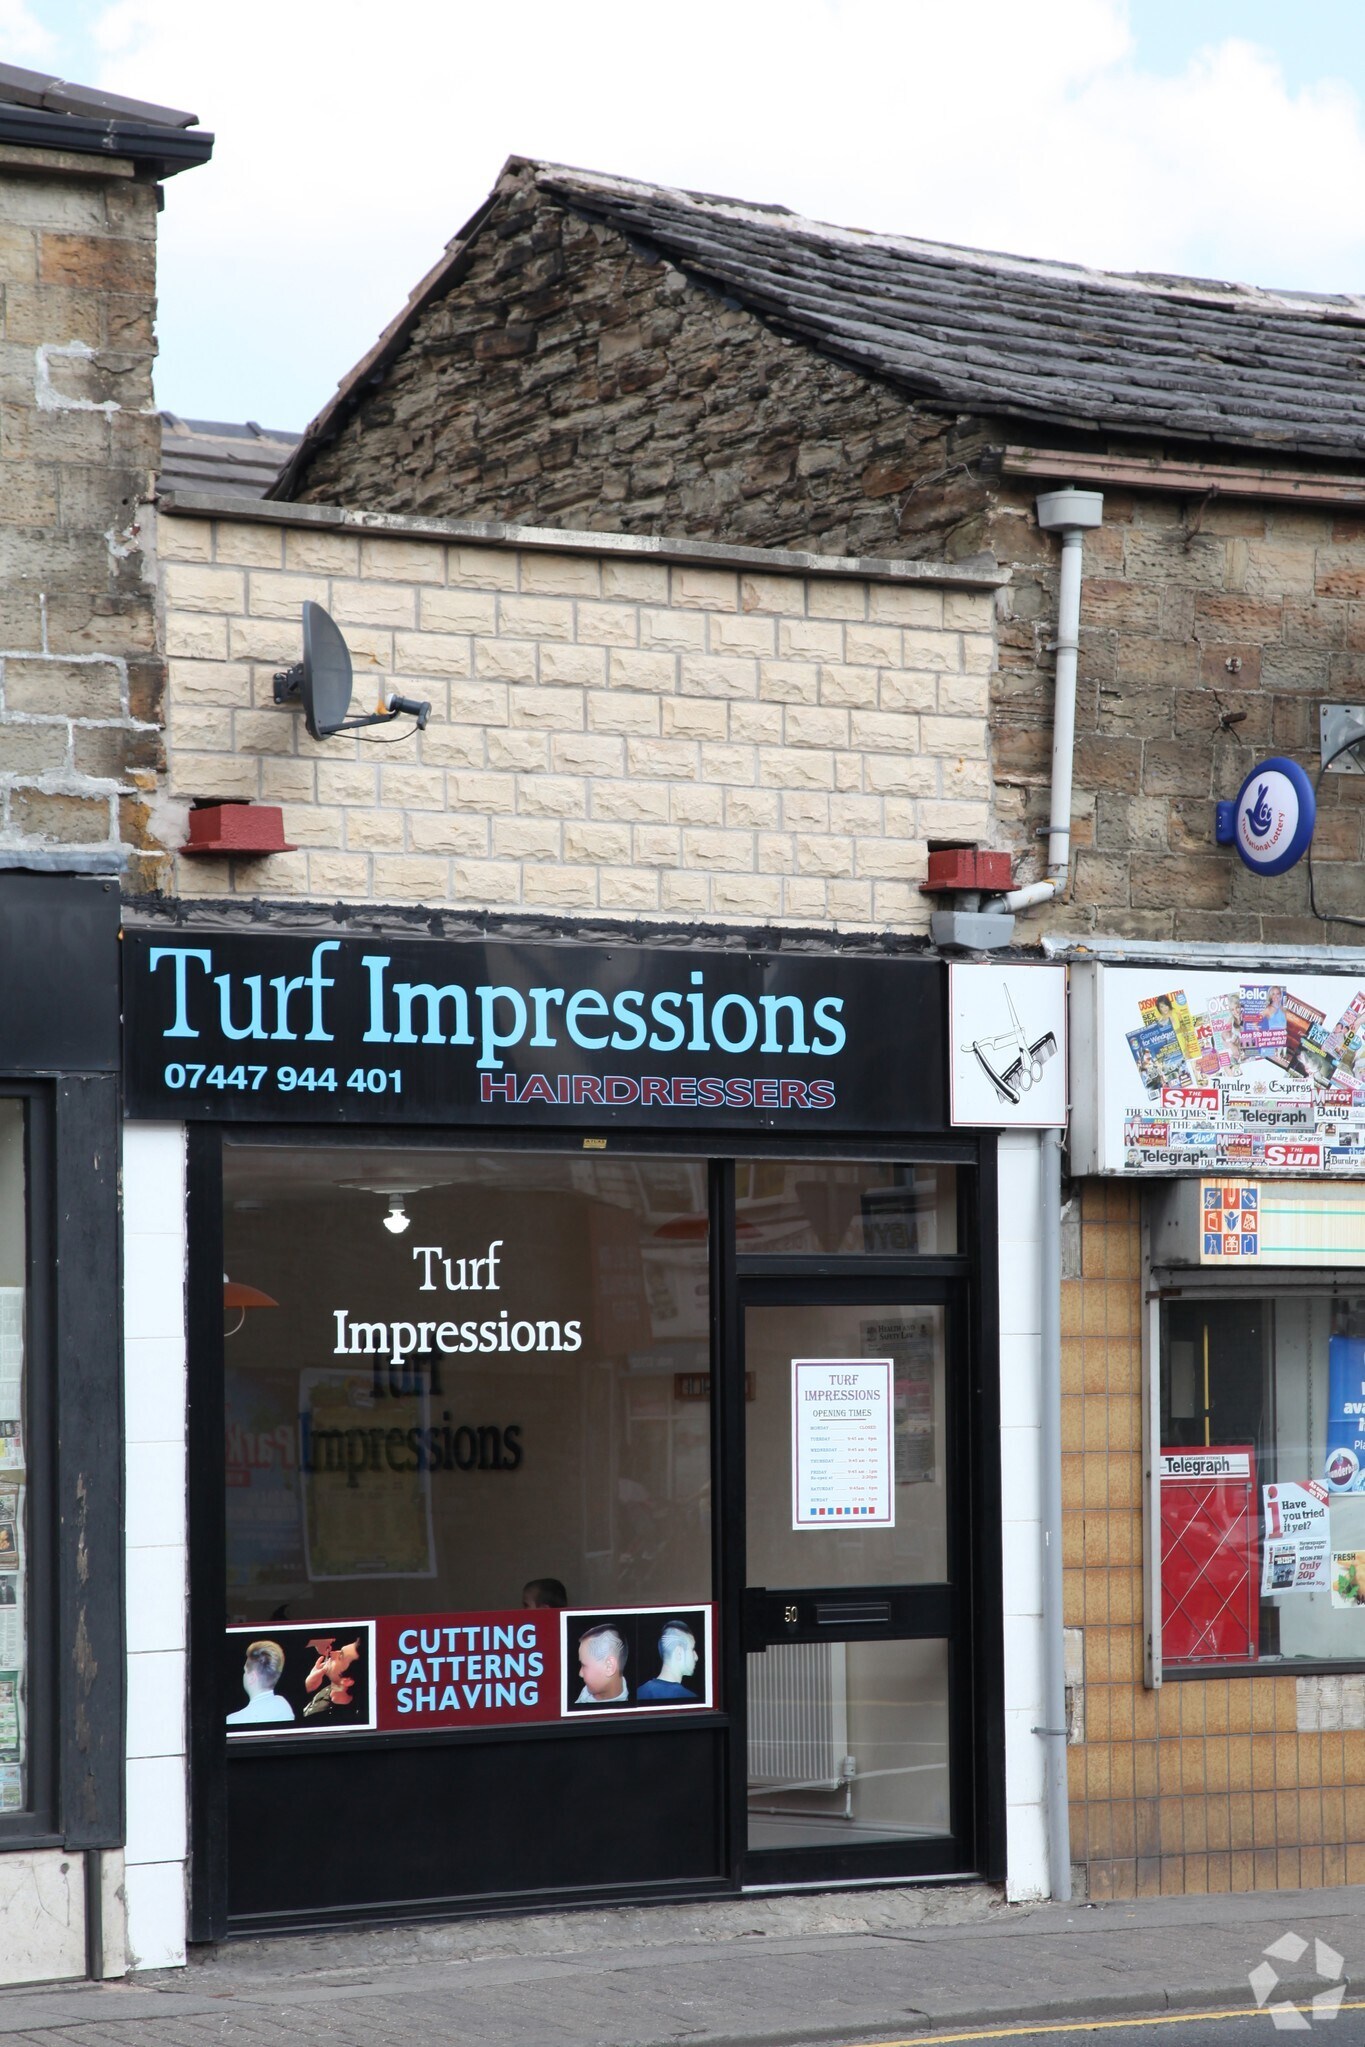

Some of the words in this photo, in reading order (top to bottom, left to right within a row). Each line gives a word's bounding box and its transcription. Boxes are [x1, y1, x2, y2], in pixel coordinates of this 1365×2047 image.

[1246, 835, 1271, 851] National
[1271, 812, 1285, 845] Lottery
[1239, 987, 1267, 1000] Bella
[150, 941, 341, 1042] Turf
[361, 956, 848, 1068] Impressions
[1143, 1012, 1156, 1020] SEX
[165, 1064, 267, 1090] 07447
[277, 1067, 337, 1092] 944
[347, 1069, 402, 1093] 401
[480, 1073, 836, 1110] HAIRDRESSERS
[1212, 1079, 1251, 1095] Burnley
[1268, 1080, 1312, 1095] Express
[1164, 1090, 1217, 1109] Sun
[1312, 1089, 1352, 1104] Mirror
[1125, 1108, 1142, 1117] THE
[1144, 1108, 1179, 1117] SUNDAY
[1180, 1109, 1207, 1119] TIMES
[1240, 1109, 1307, 1126] Telegraph
[1316, 1106, 1349, 1120] Daily
[1125, 1123, 1166, 1138] Mirror
[1172, 1121, 1192, 1130] THE
[1215, 1121, 1244, 1130] TIMES
[1217, 1134, 1251, 1147] Mirror
[1266, 1133, 1289, 1142] Burnley
[1298, 1134, 1323, 1142] Express
[1140, 1150, 1208, 1165] Telegraph
[1267, 1146, 1318, 1166] Sun
[1331, 1155, 1359, 1167] Burnley
[412, 1240, 504, 1291] Turf
[878, 1324, 901, 1333] HEALTH
[879, 1332, 900, 1340] SAFETY
[901, 1332, 914, 1340] LAW
[332, 1310, 582, 1365] Impressions
[828, 1374, 859, 1386] TURF
[804, 1390, 881, 1401] IMPRESSIONS
[812, 1409, 847, 1417] OPENING
[848, 1409, 872, 1417] TIMES
[1165, 1456, 1230, 1476] Telegraph
[1308, 1481, 1318, 1489] As
[1315, 1485, 1329, 1499] seen
[1315, 1491, 1325, 1501] TV
[1267, 1485, 1283, 1539] i
[1282, 1500, 1307, 1510] Have
[1283, 1512, 1301, 1523] you
[1302, 1508, 1325, 1518] tried
[1284, 1523, 1291, 1533] it
[1292, 1521, 1312, 1533] yet?
[1333, 1553, 1356, 1561] FRESH
[1299, 1561, 1321, 1571] Only
[1297, 1571, 1316, 1580] 20p
[784, 1606, 798, 1623] 50
[398, 1624, 537, 1656] CUTTING
[390, 1651, 544, 1685] PATTERNS
[397, 1681, 539, 1714] SHAVING
